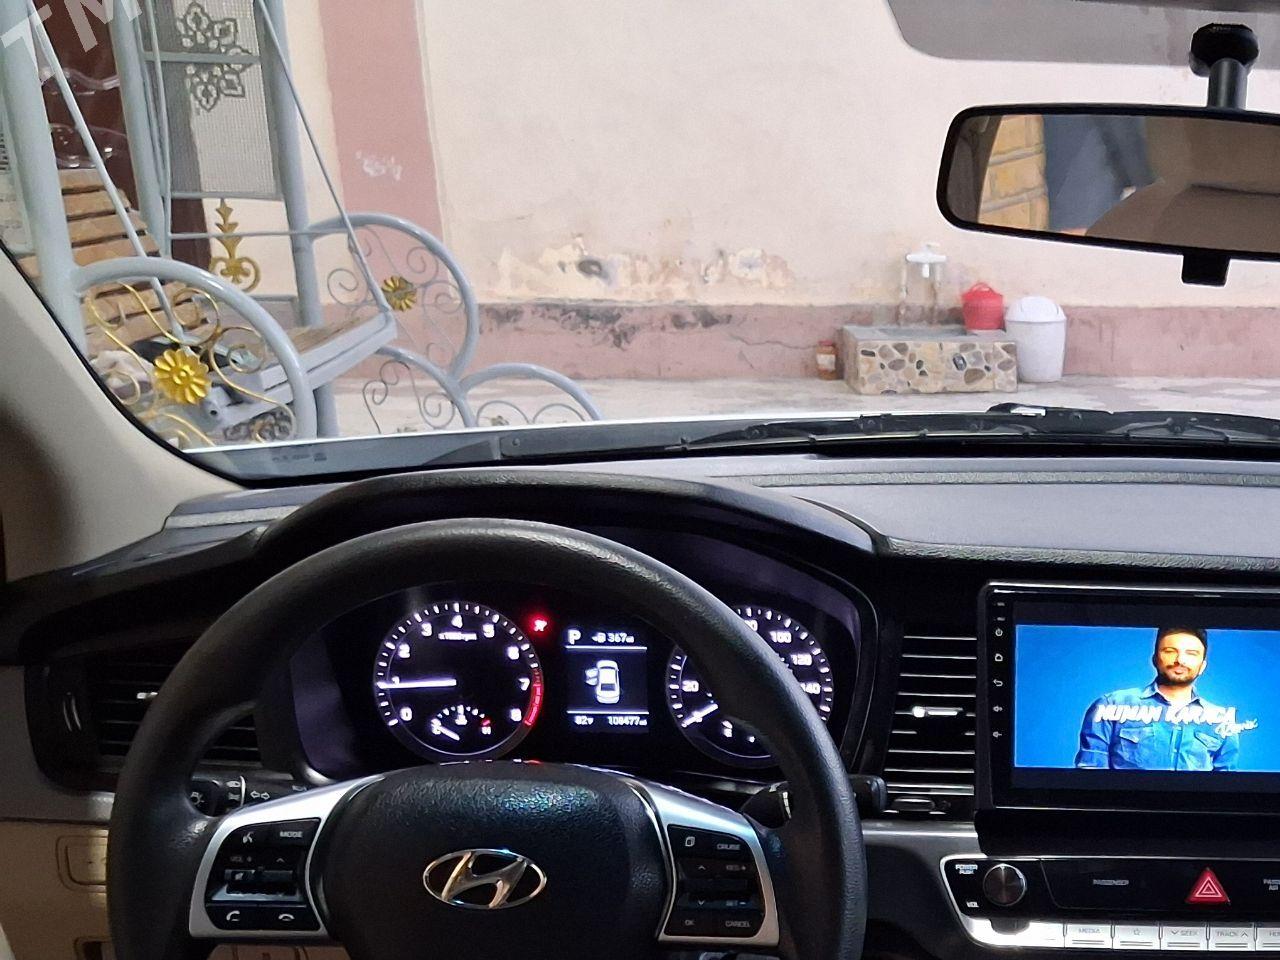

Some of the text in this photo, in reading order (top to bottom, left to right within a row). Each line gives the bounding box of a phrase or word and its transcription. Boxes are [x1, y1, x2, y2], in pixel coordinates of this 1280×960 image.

[421, 623, 432, 636] 3
[568, 629, 581, 645] P
[769, 630, 792, 643] 100
[398, 643, 411, 658] 2
[791, 653, 813, 666] 120
[519, 677, 531, 691] 7
[682, 680, 700, 692] 20
[400, 707, 412, 721] 0
